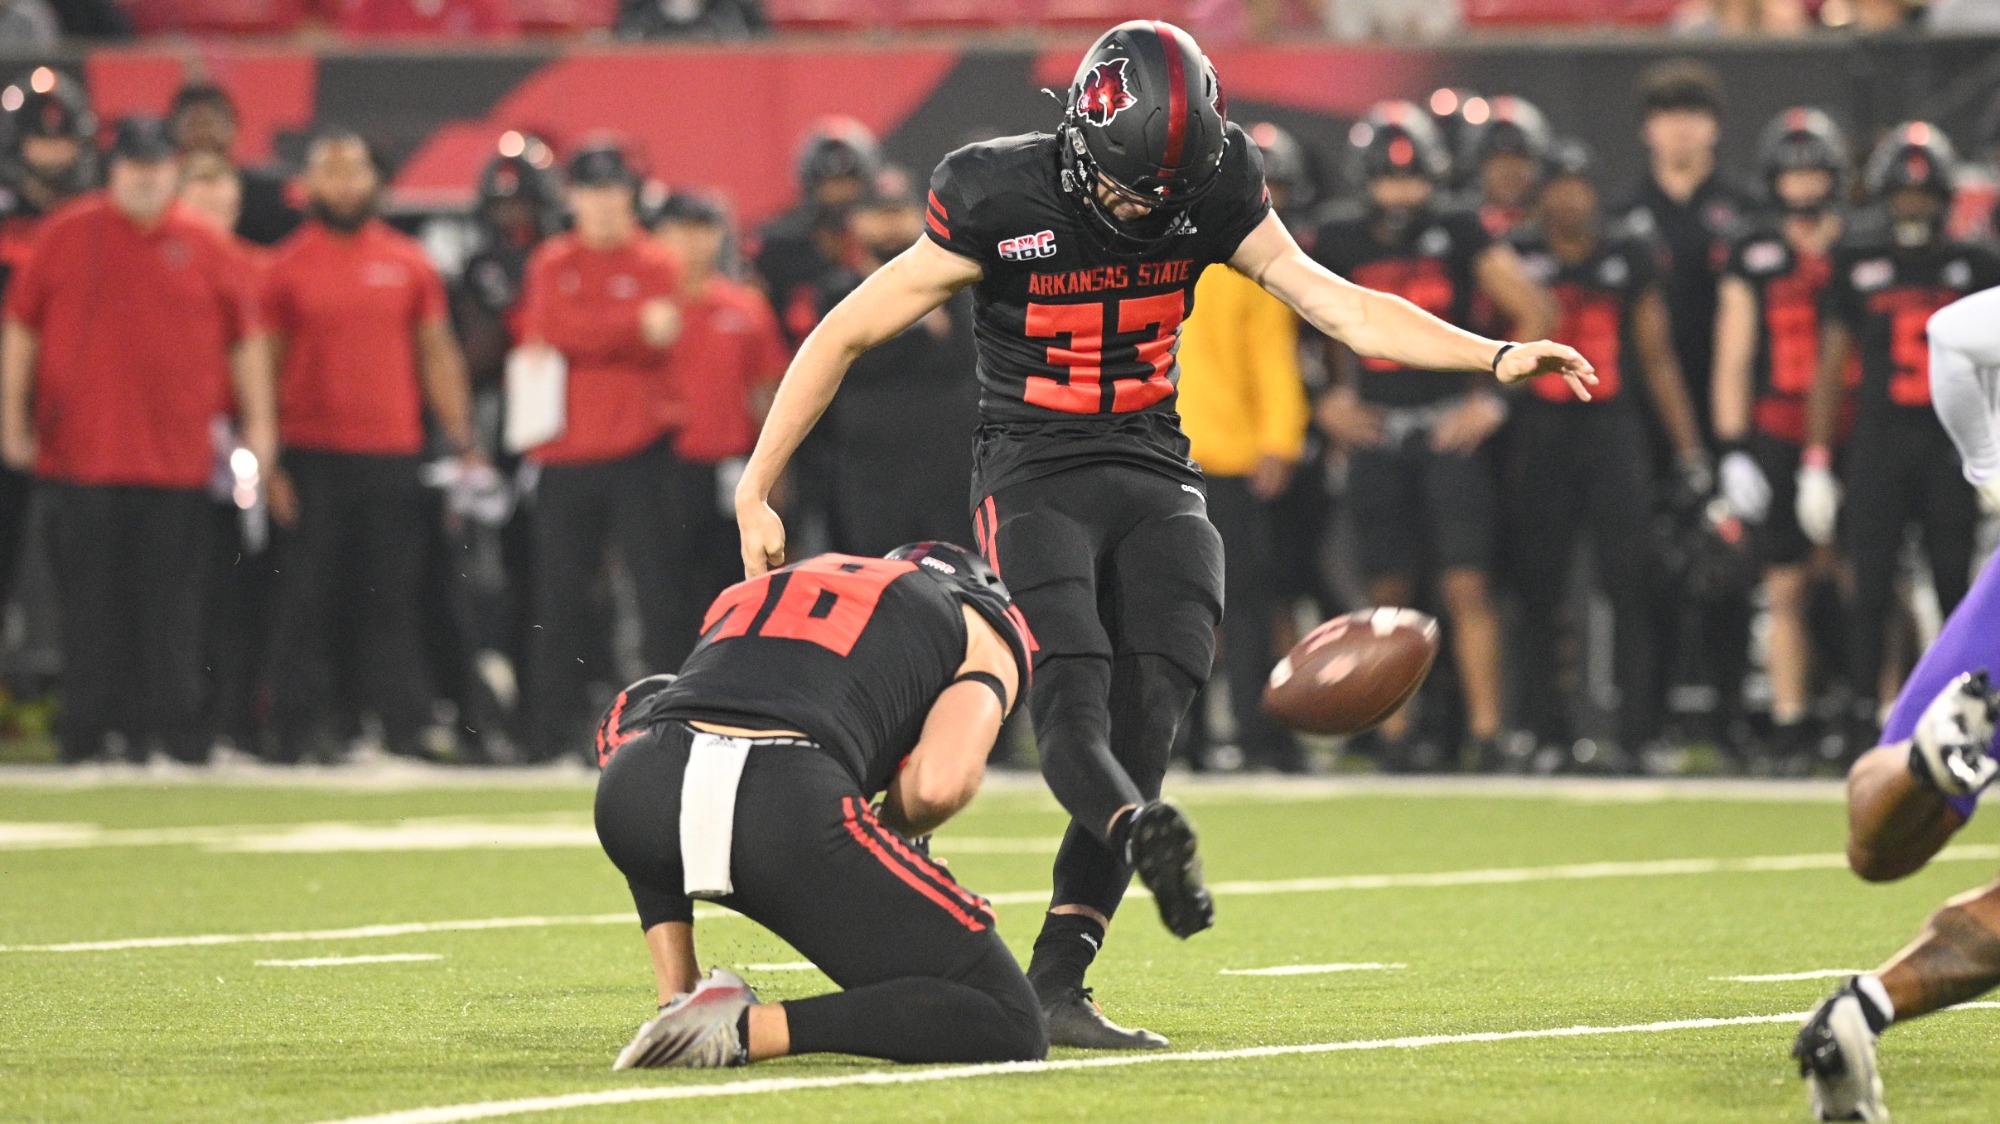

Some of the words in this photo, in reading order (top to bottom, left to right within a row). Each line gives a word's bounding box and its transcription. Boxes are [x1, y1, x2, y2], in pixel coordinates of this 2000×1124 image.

[998, 230, 1057, 261] SBC
[1028, 265, 1128, 296] ARKANSAS
[1137, 259, 1194, 287] STATE
[1023, 288, 1185, 414] 33
